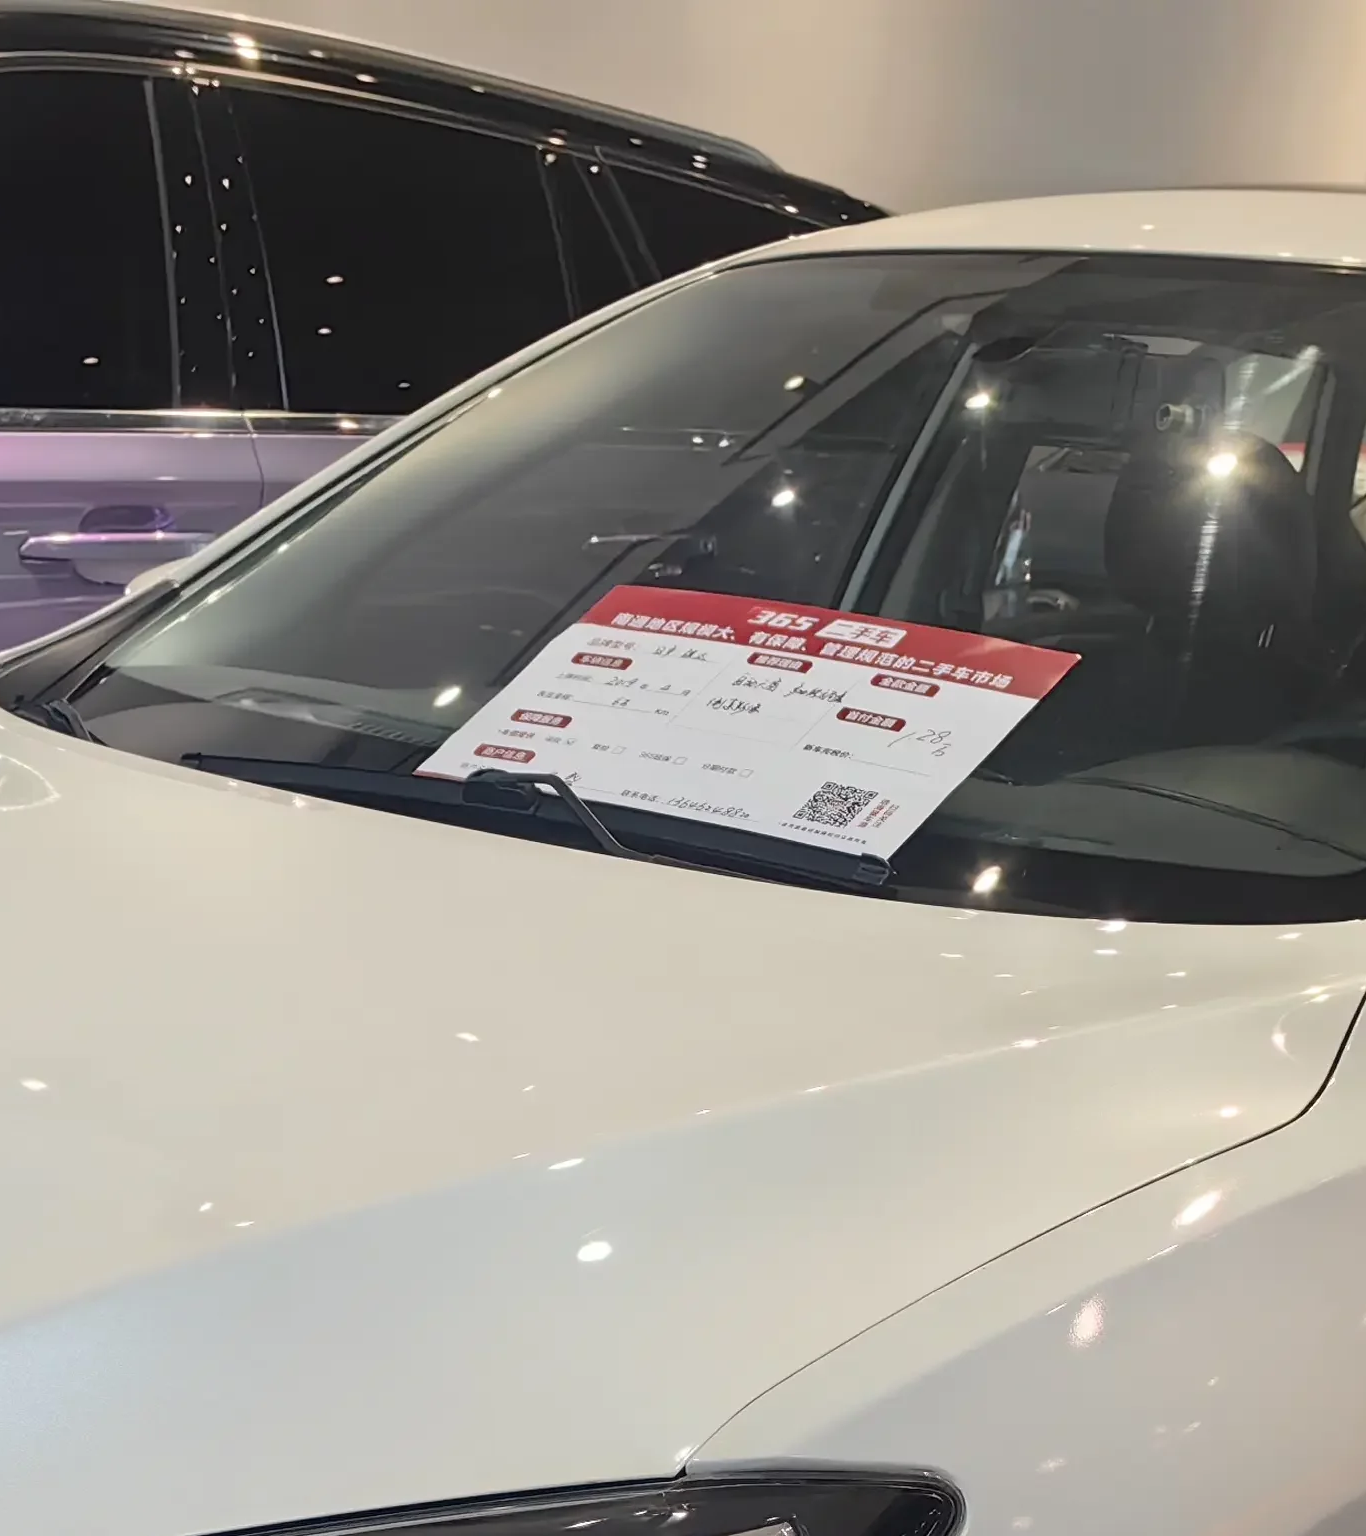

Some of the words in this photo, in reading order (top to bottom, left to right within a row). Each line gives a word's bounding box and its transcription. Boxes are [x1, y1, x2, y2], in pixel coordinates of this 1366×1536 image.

[747, 609, 820, 632] 365
[825, 621, 899, 643] 二手车
